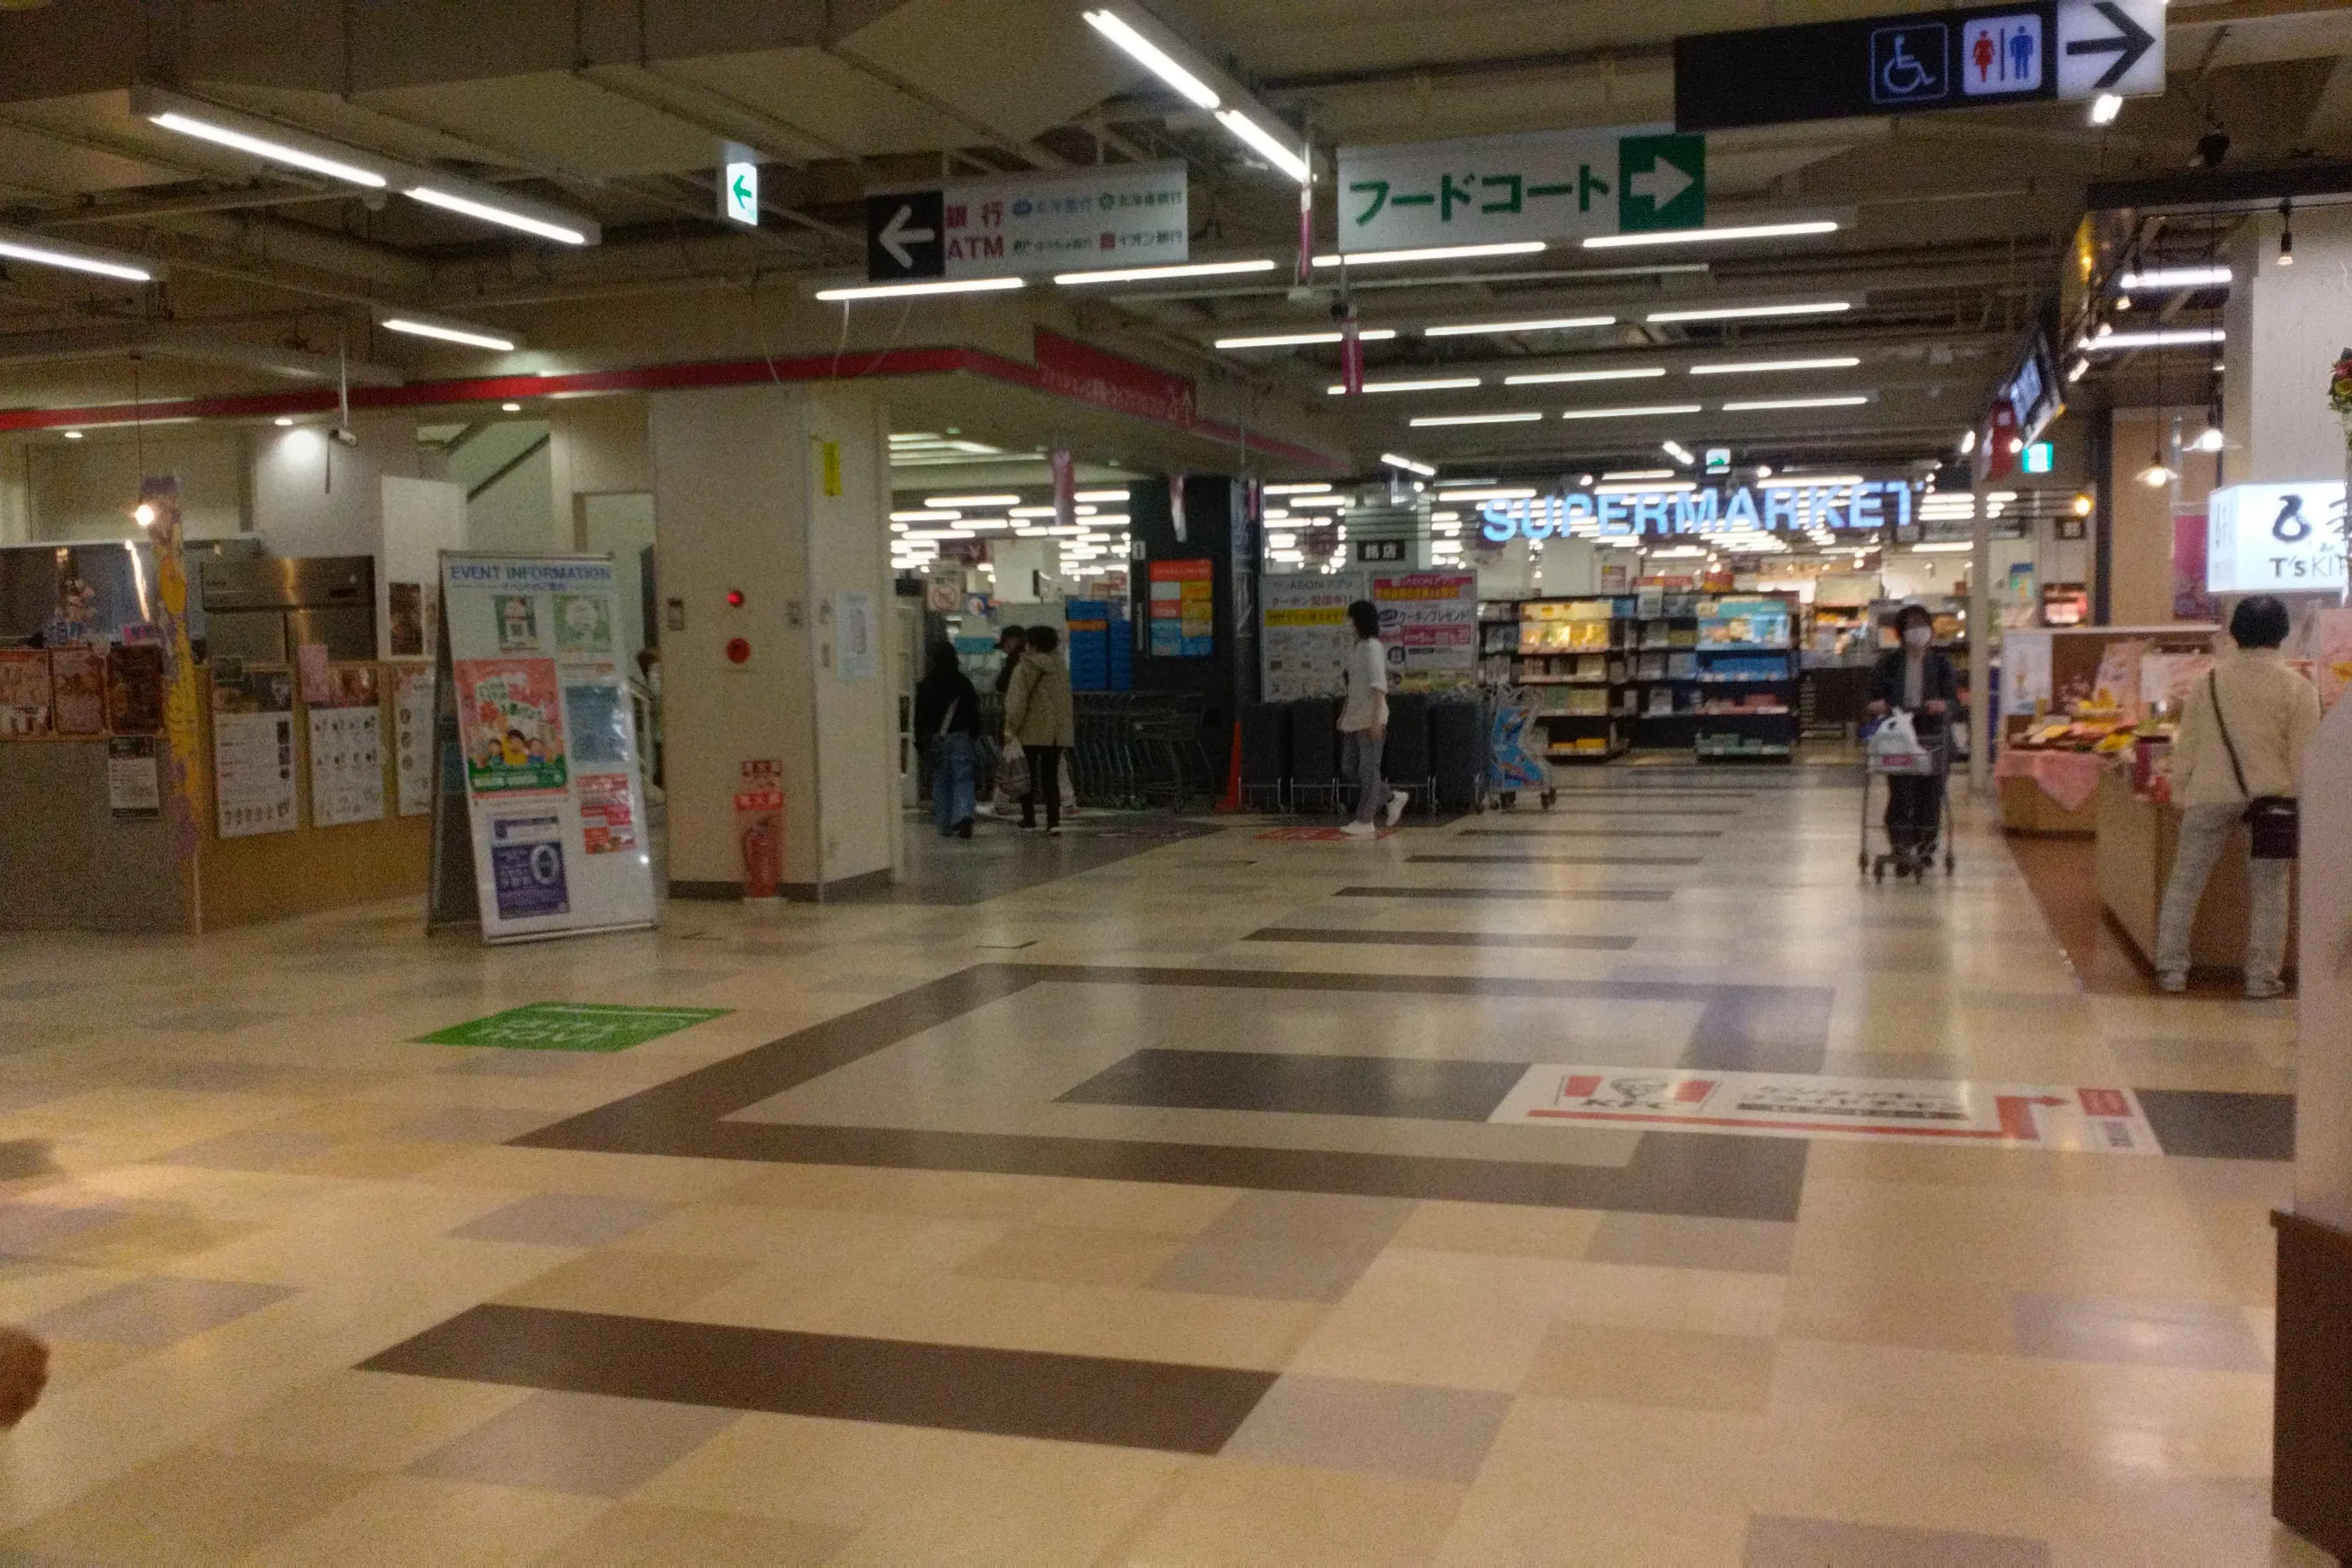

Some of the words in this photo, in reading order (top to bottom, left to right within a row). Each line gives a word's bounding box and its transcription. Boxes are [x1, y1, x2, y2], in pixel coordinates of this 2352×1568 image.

[1349, 164, 1610, 226] フードコート
[946, 236, 1004, 260] ATM
[1483, 480, 1924, 541] SUPERMARKET
[451, 565, 500, 580] EVENT
[506, 565, 611, 580] INFORMATION
